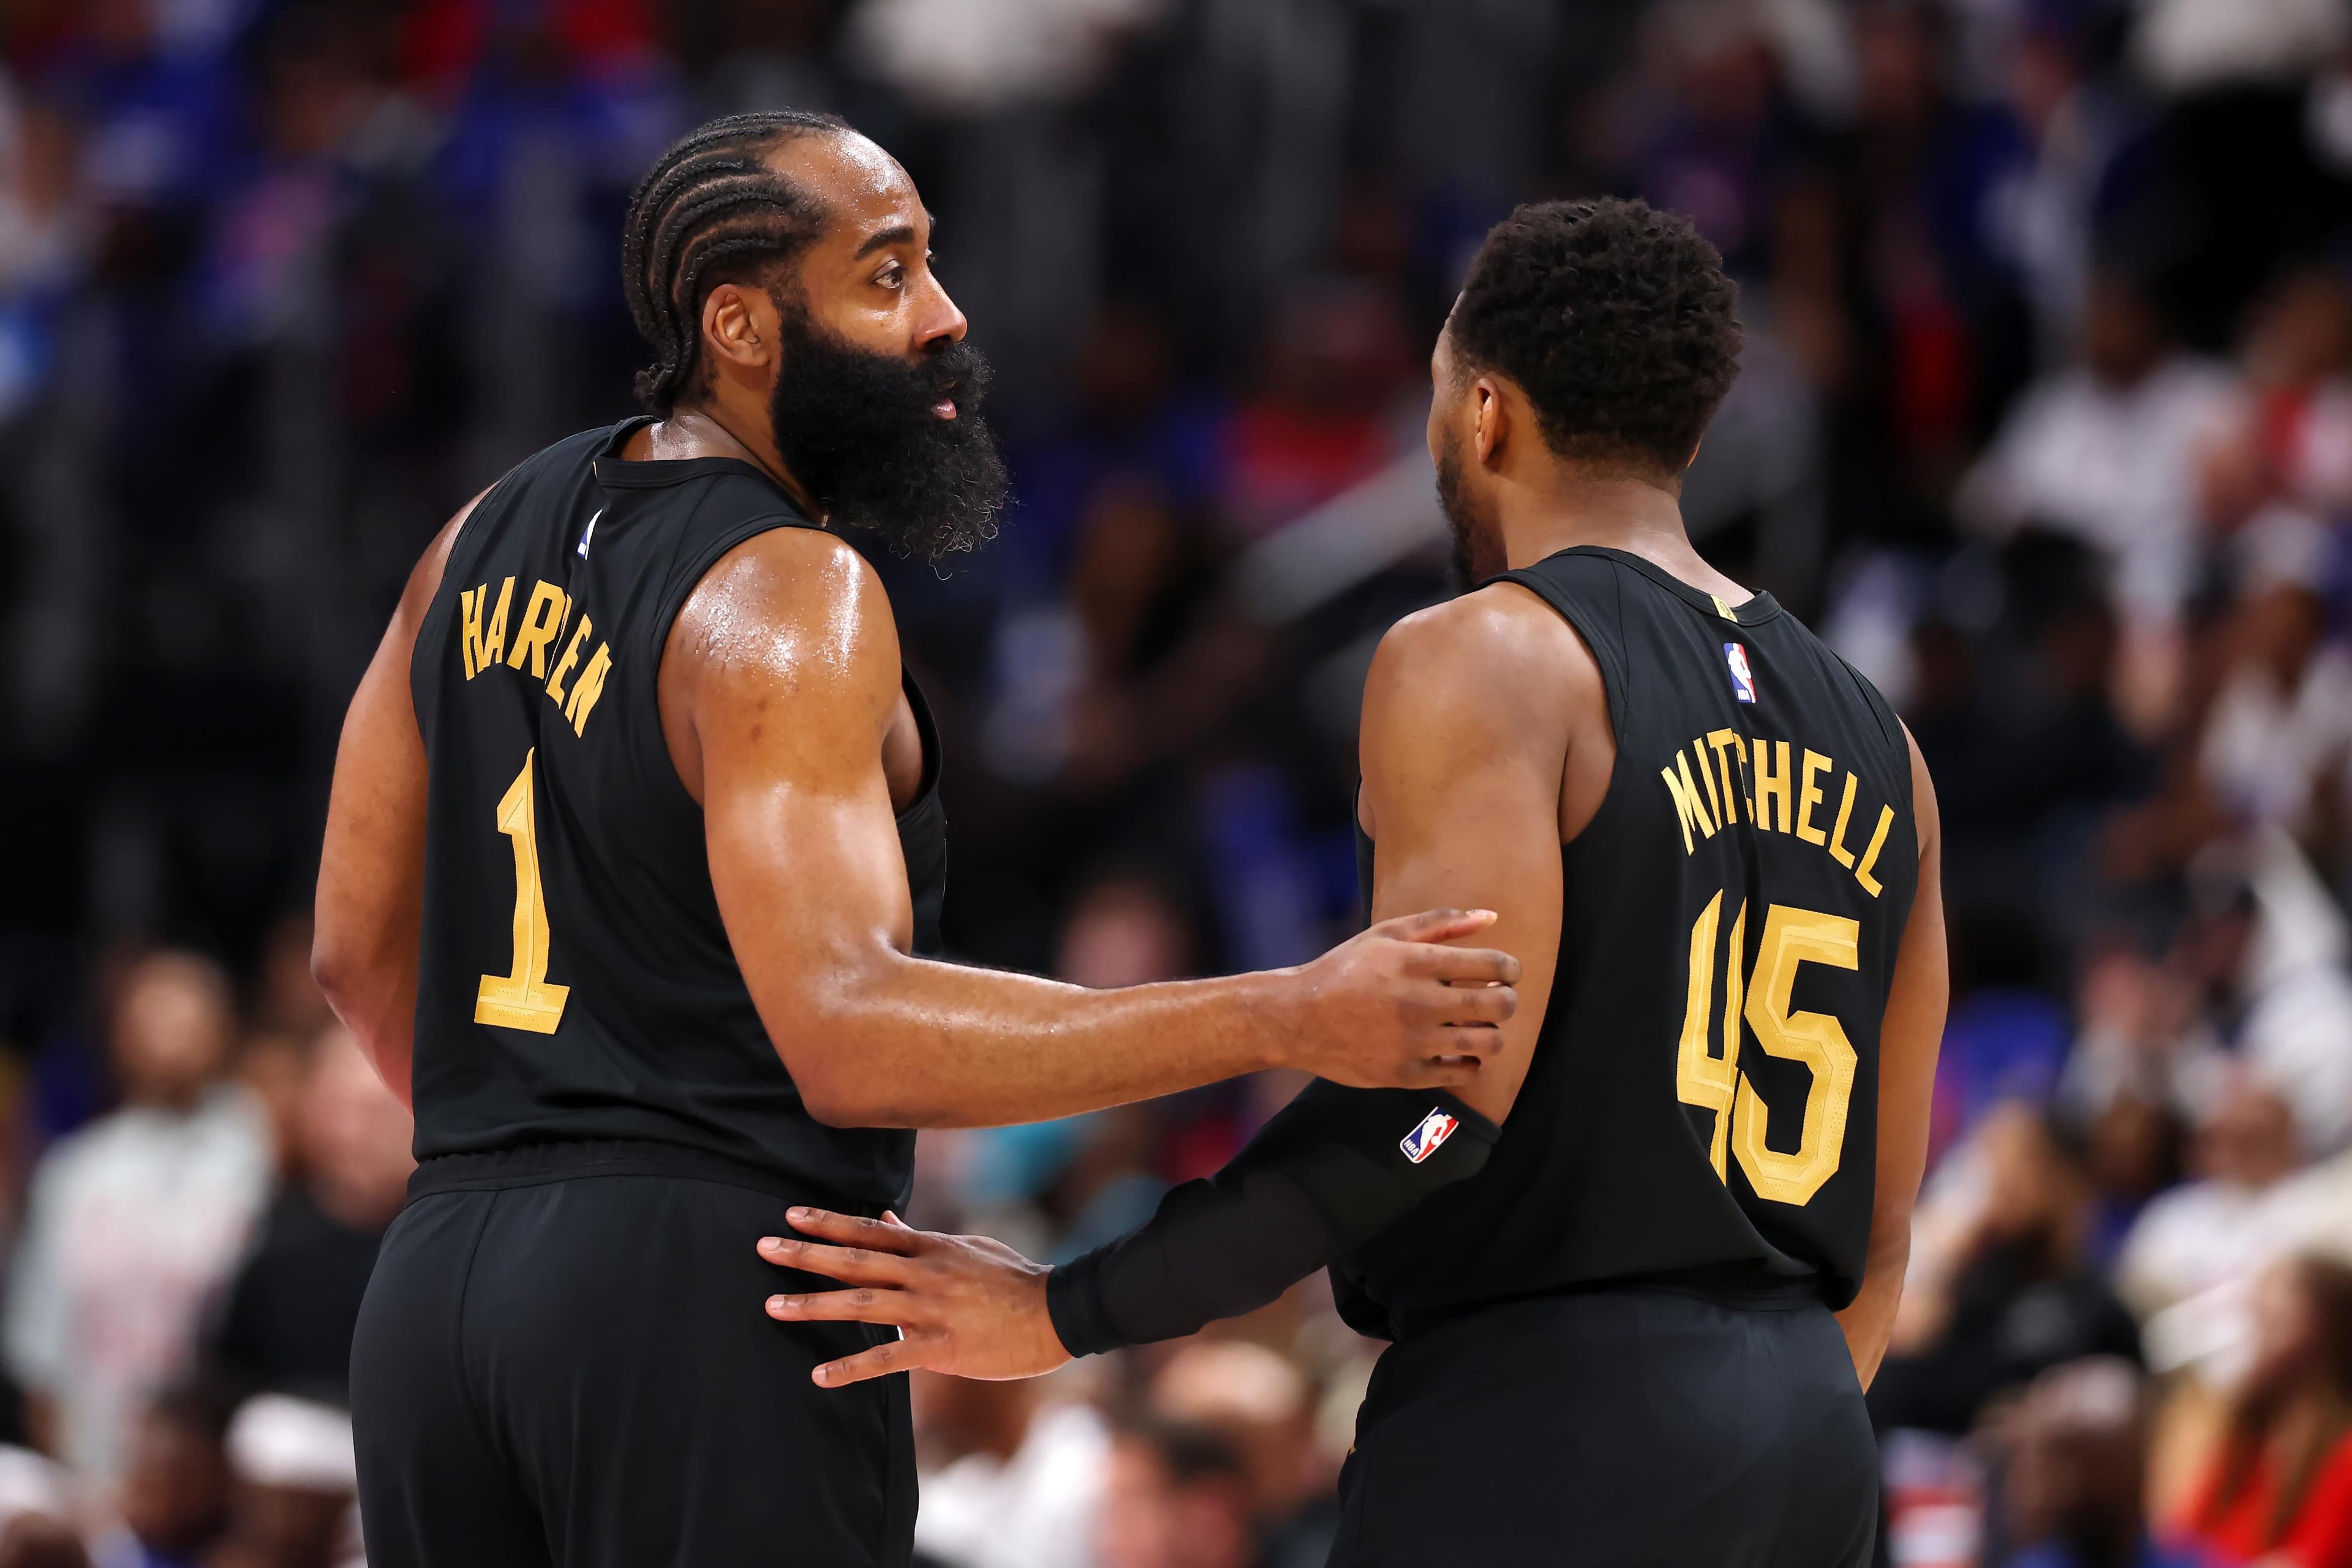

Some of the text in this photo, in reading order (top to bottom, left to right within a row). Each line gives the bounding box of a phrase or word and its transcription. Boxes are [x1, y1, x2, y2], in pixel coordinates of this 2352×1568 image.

[461, 576, 612, 738] HAREN
[1737, 689, 1751, 701] NBA
[473, 747, 571, 1036] 1
[1676, 888, 1860, 1207] 45
[1403, 1139, 1420, 1156] NBA
